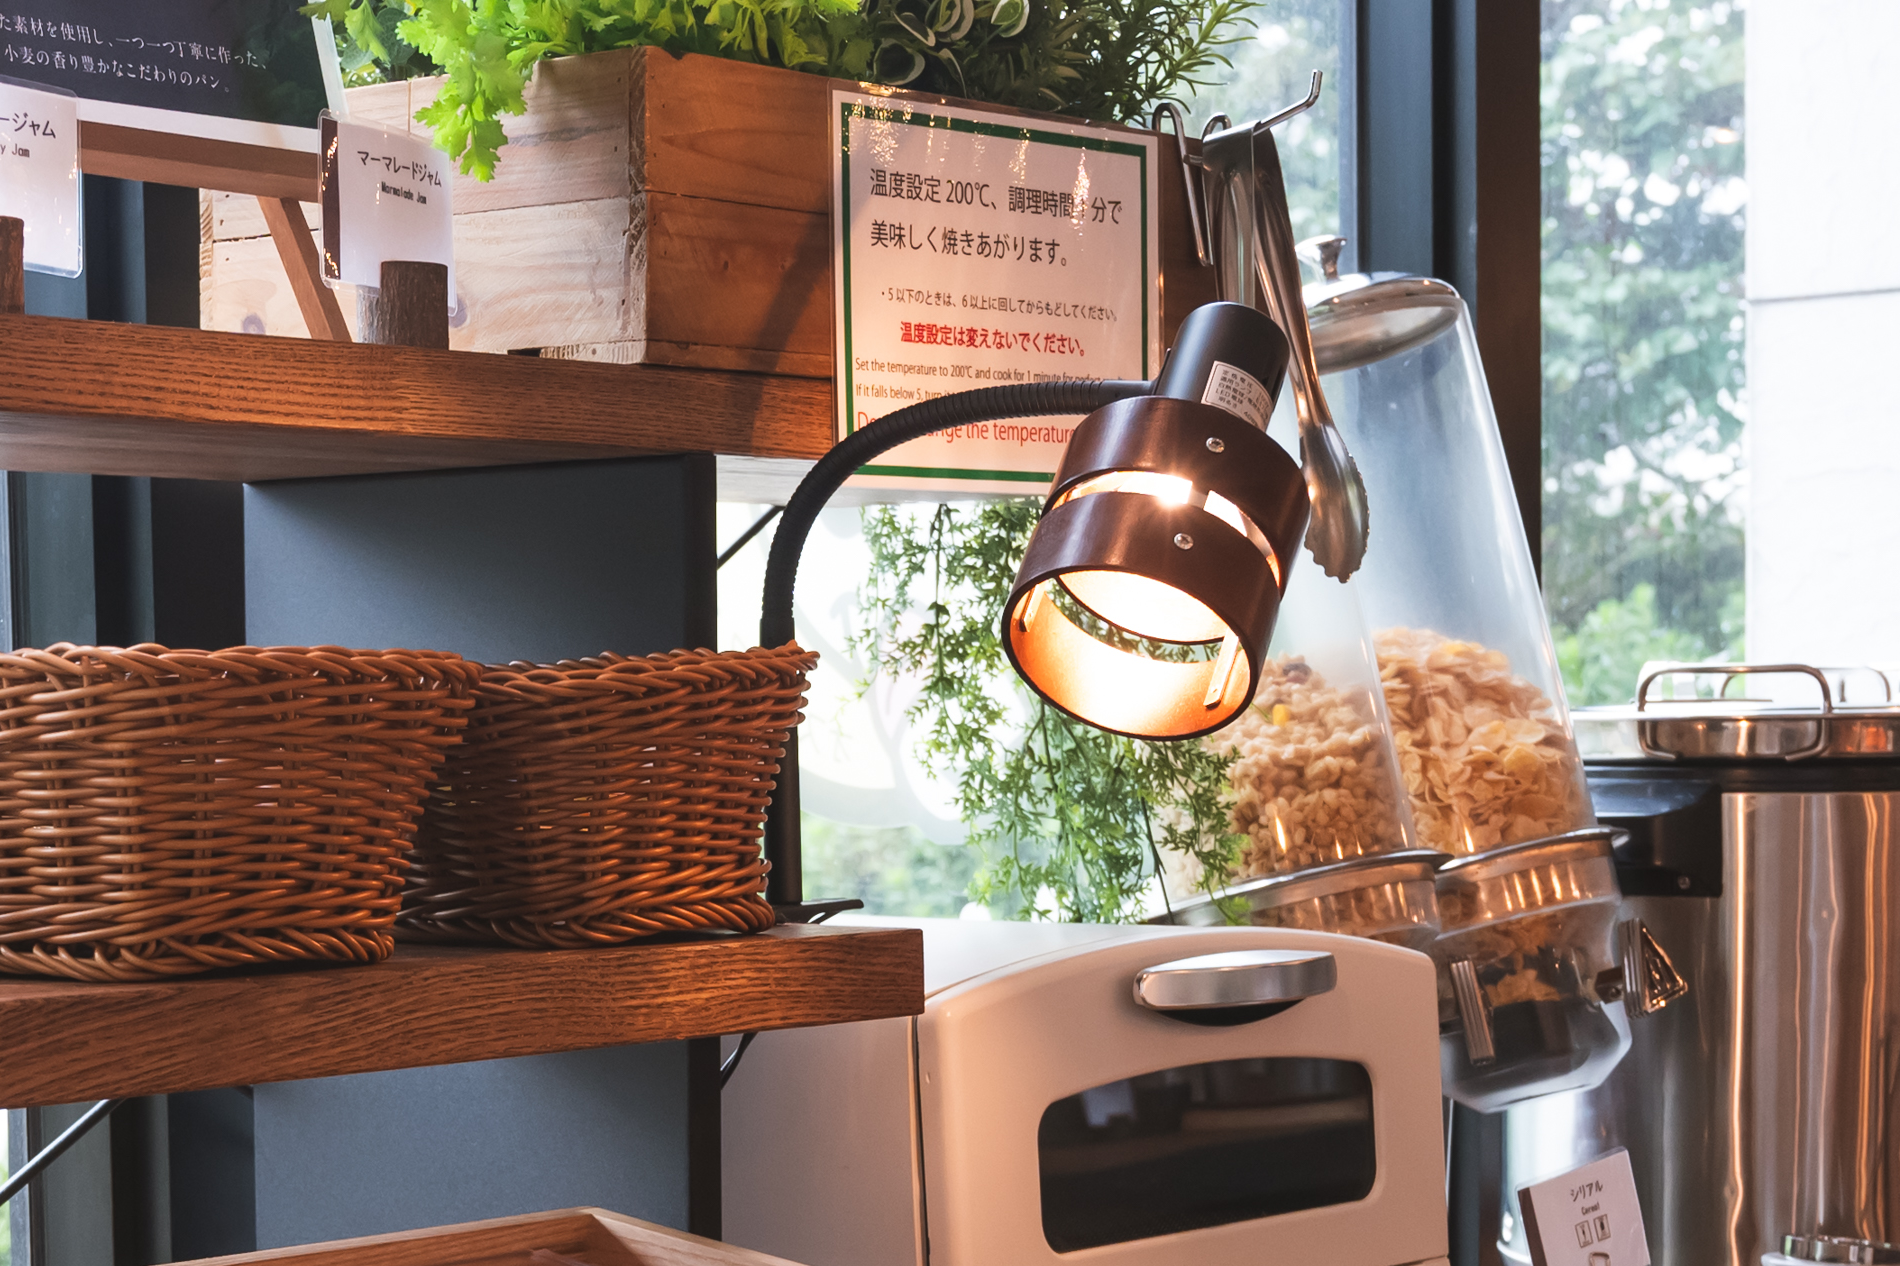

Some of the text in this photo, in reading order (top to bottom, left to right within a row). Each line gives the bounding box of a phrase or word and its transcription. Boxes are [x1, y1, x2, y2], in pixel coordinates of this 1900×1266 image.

[4, 43, 230, 93] 小麦の香り豊かなこだわりのパン。
[12, 143, 30, 158] Jam
[357, 150, 442, 188] マーマレードジャム
[381, 180, 427, 205] Marmalade Jam
[870, 219, 1067, 267] 美味しく焼きあがります。
[899, 320, 1085, 357] 温度設定は変えないでください。
[855, 357, 869, 371] Set
[871, 358, 885, 372] the
[887, 362, 937, 376] temperature
[939, 365, 948, 377] to
[975, 367, 991, 380] and
[993, 368, 1012, 381] cook
[1014, 369, 1025, 381] for
[1027, 370, 1031, 382] 1
[1033, 371, 1061, 382] minute
[856, 383, 863, 397] If
[864, 384, 869, 397] it
[871, 384, 888, 398] falls
[890, 386, 915, 400] below
[967, 422, 989, 440] the
[1570, 1179, 1604, 1202] シリアル
[1581, 1202, 1600, 1216] Cereal
